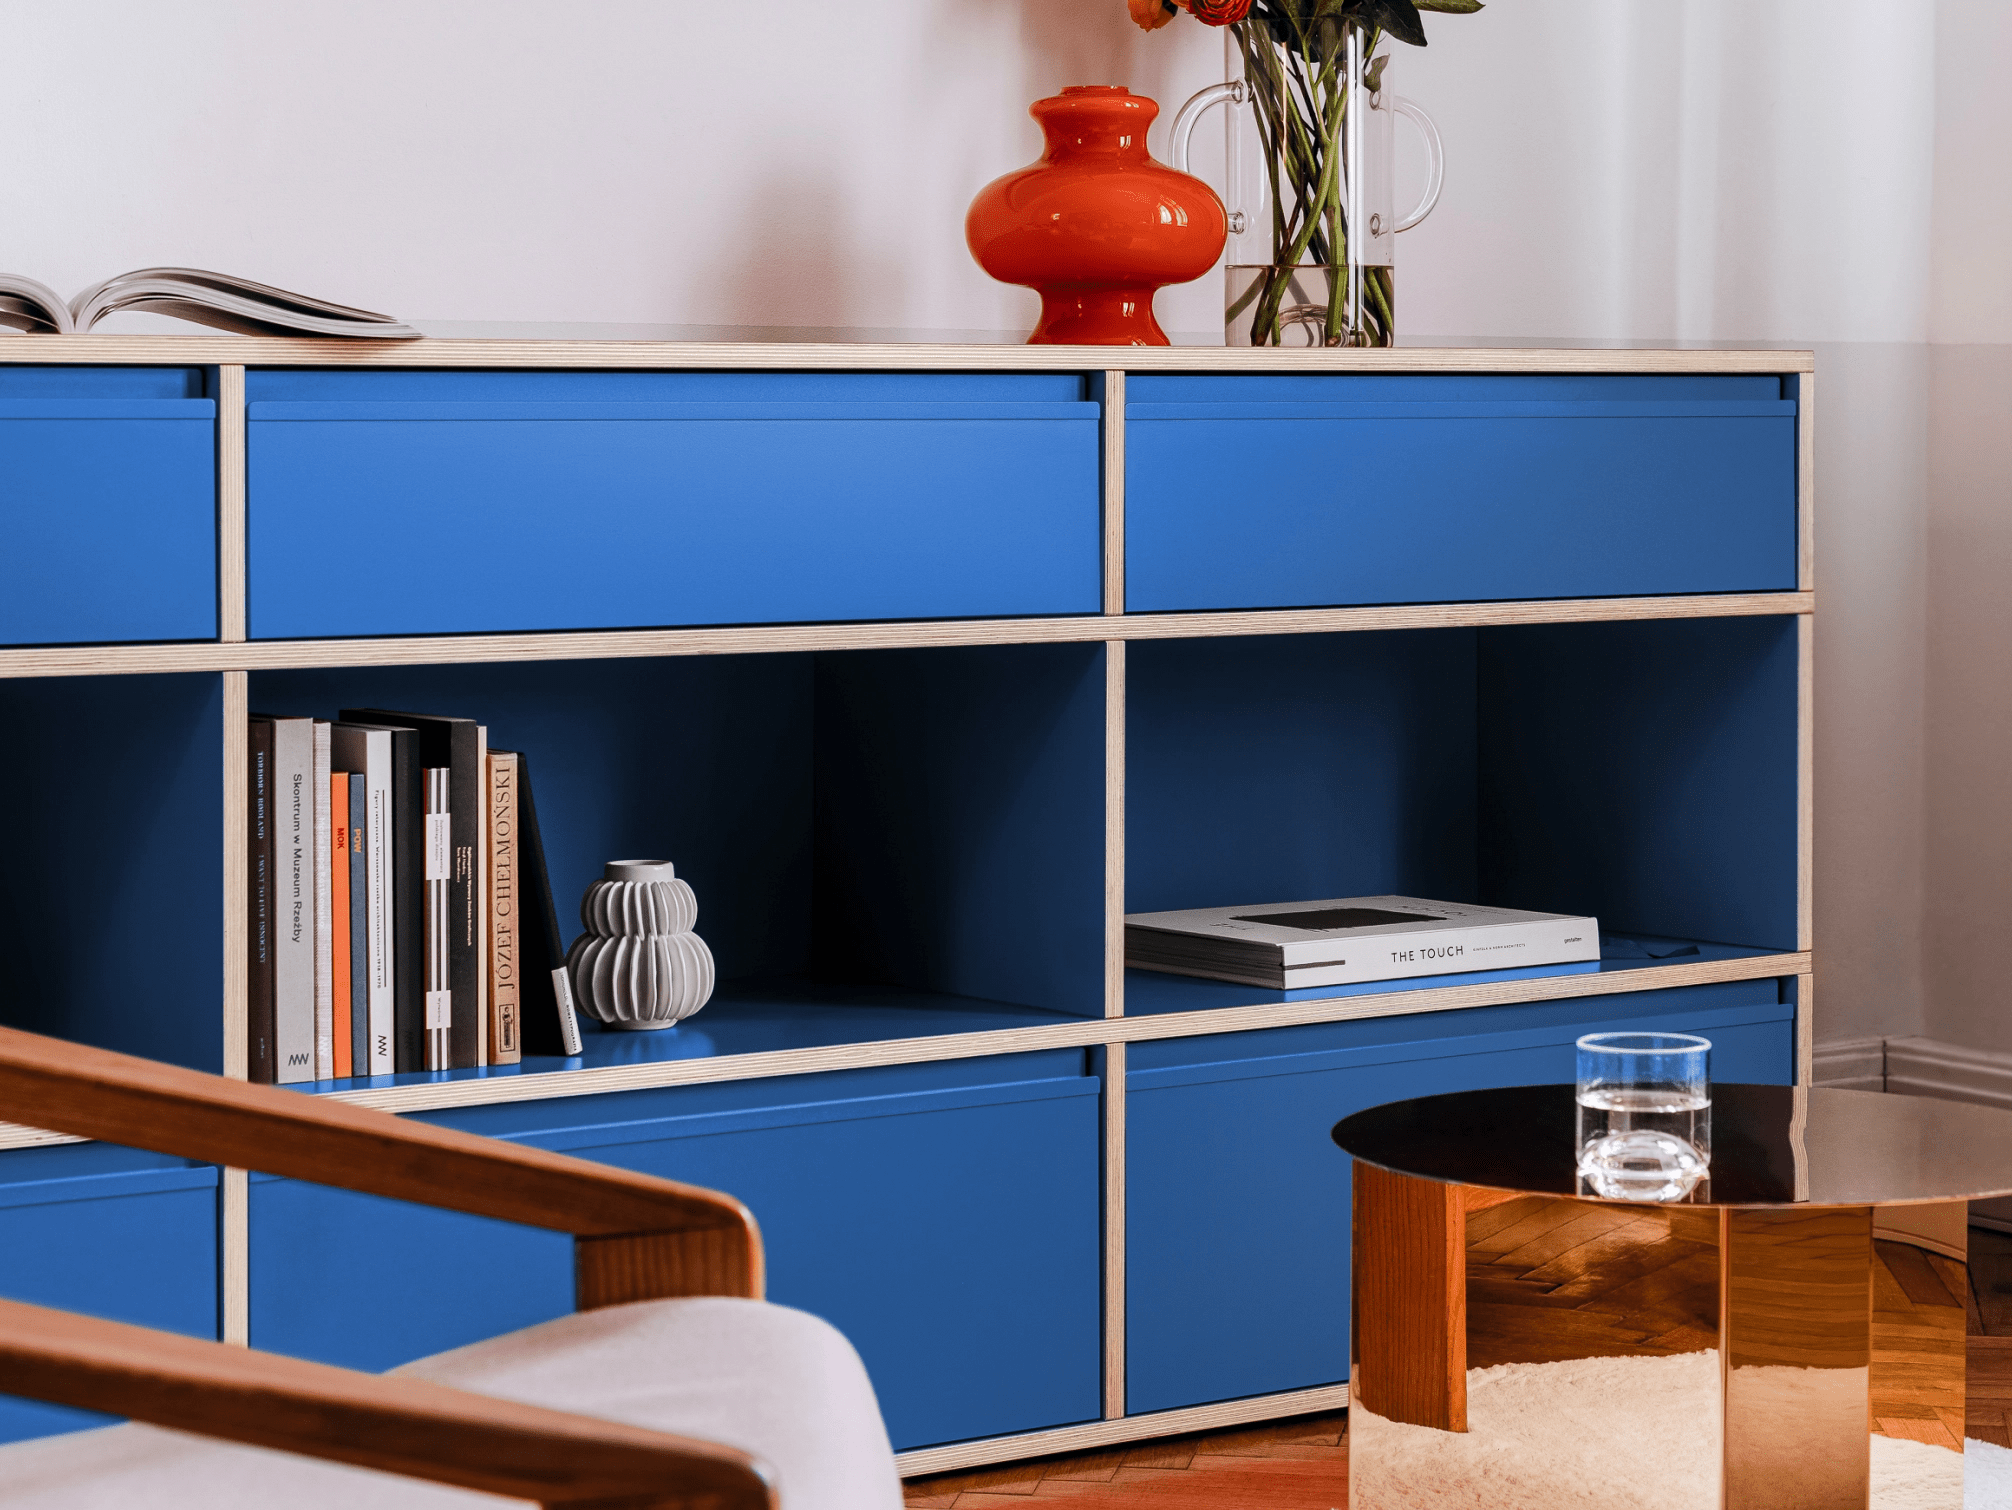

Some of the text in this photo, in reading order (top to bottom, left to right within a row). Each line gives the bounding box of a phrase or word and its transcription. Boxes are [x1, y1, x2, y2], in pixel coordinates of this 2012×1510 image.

[337, 828, 345, 850] MOK
[353, 828, 362, 853] POW
[292, 773, 303, 944] Skontrum w Muzeum Rzeźby
[494, 767, 515, 990] JÓZEF CHEŁMOŃSKI
[1391, 945, 1464, 963] THE TOUCH
